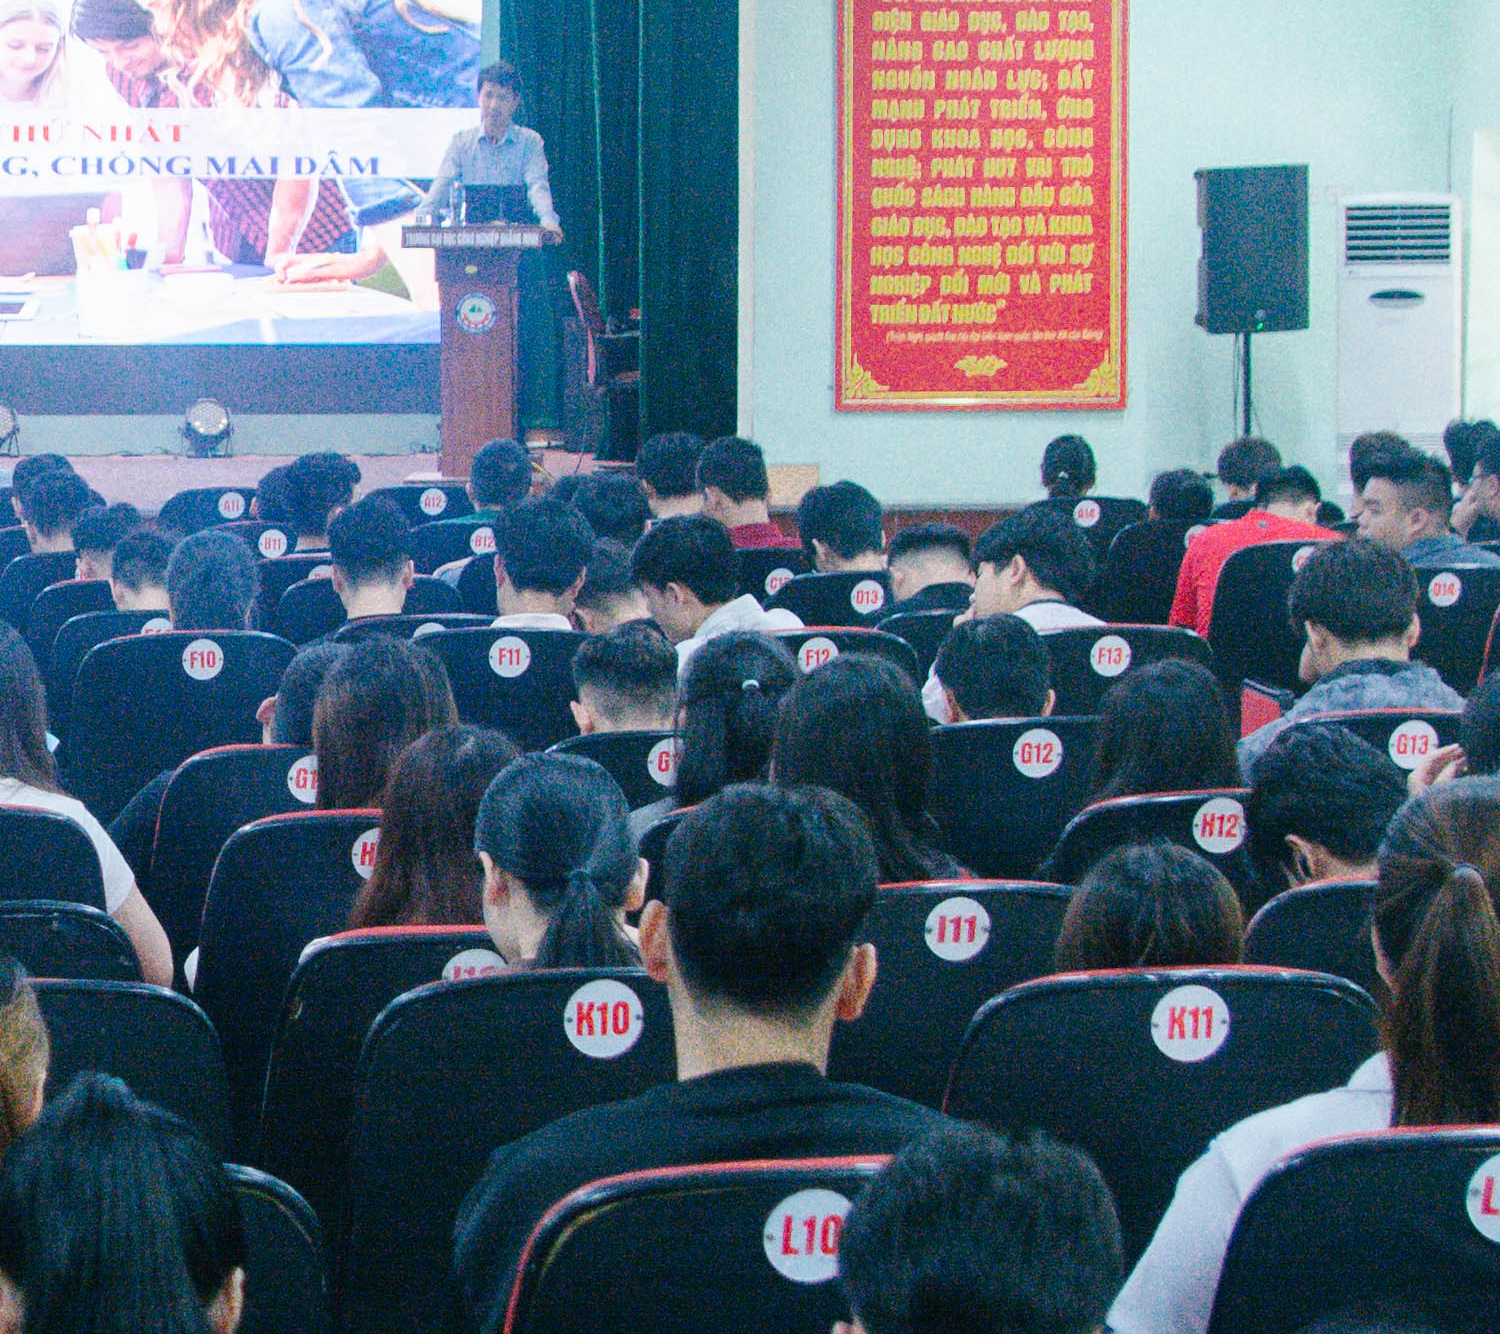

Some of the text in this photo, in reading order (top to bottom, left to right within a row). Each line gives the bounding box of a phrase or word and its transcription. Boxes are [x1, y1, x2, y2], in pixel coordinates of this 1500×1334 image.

[206, 155, 279, 177] MAI
[295, 149, 380, 177] DÂM
[424, 496, 442, 507] A12
[190, 651, 215, 667] F10
[498, 648, 521, 665] F11
[1098, 648, 1122, 664] F13
[1020, 743, 1054, 763] G12
[1397, 733, 1428, 756] G13
[1202, 813, 1240, 839] H12
[576, 1002, 631, 1035] K10
[1168, 1007, 1214, 1039] K11
[781, 1215, 843, 1255] L10
